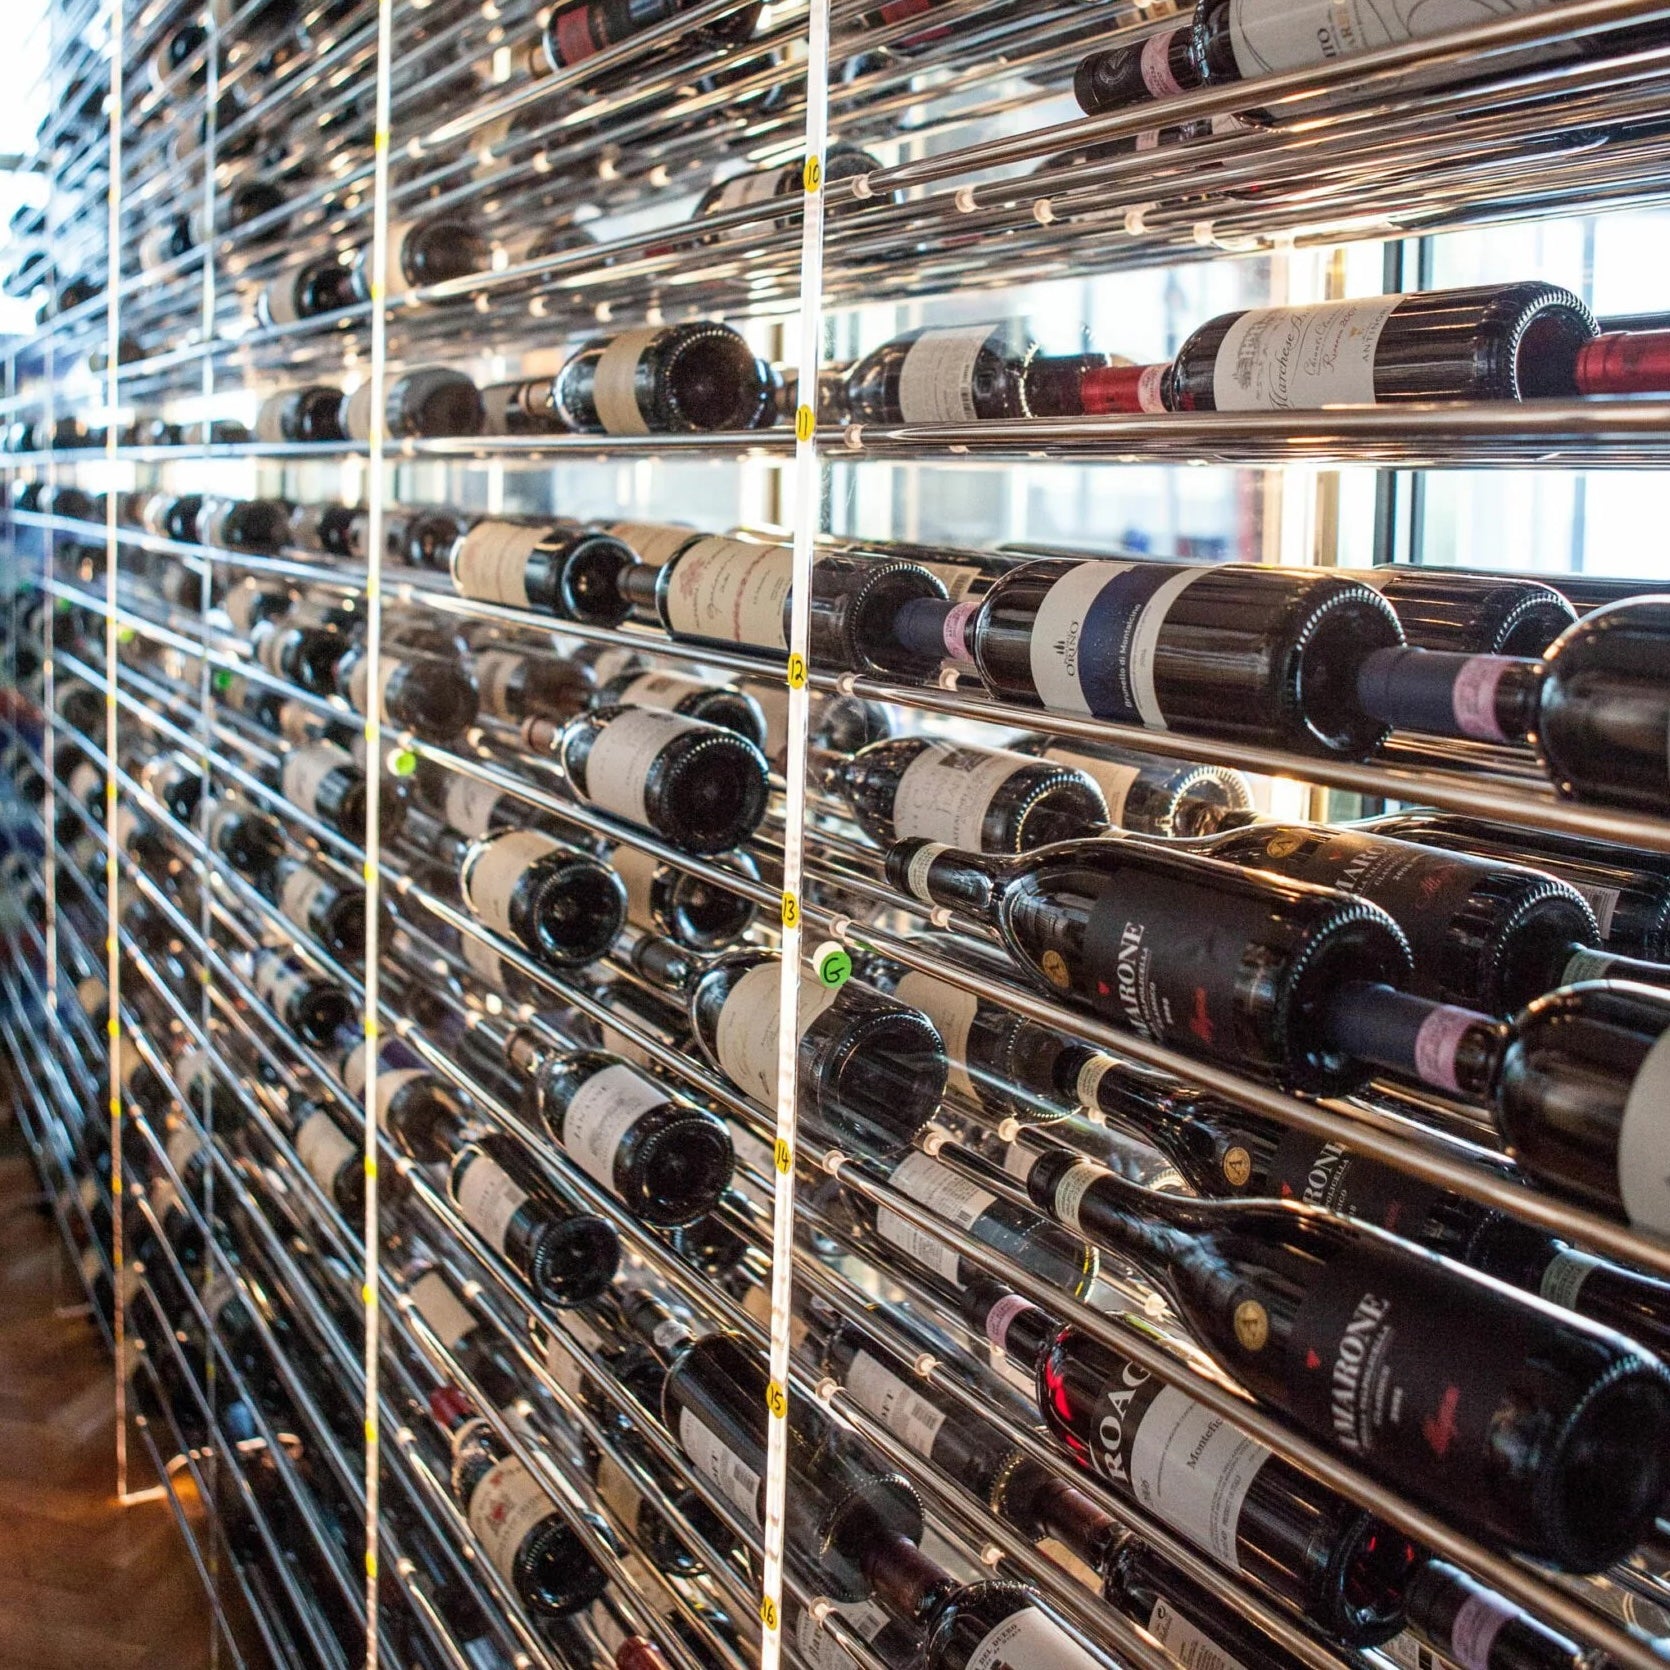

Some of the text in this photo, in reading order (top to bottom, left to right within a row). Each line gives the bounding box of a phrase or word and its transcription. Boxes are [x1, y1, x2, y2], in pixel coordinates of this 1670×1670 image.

[1269, 333, 1294, 410] Marchese
[1120, 603, 1142, 654] Montalcino
[1066, 621, 1079, 677] ORINO
[791, 659, 805, 682] 12
[1119, 668, 1133, 708] Brunello
[784, 898, 795, 921] 13
[823, 957, 845, 984] G
[1117, 922, 1150, 1034] MARONE
[777, 1143, 789, 1172] 14
[771, 1386, 783, 1411] 15
[1100, 1361, 1151, 1484] ROAG
[1186, 1418, 1223, 1470] Montefic
[763, 1599, 774, 1625] 16
[992, 1623, 1017, 1647] DUERO
